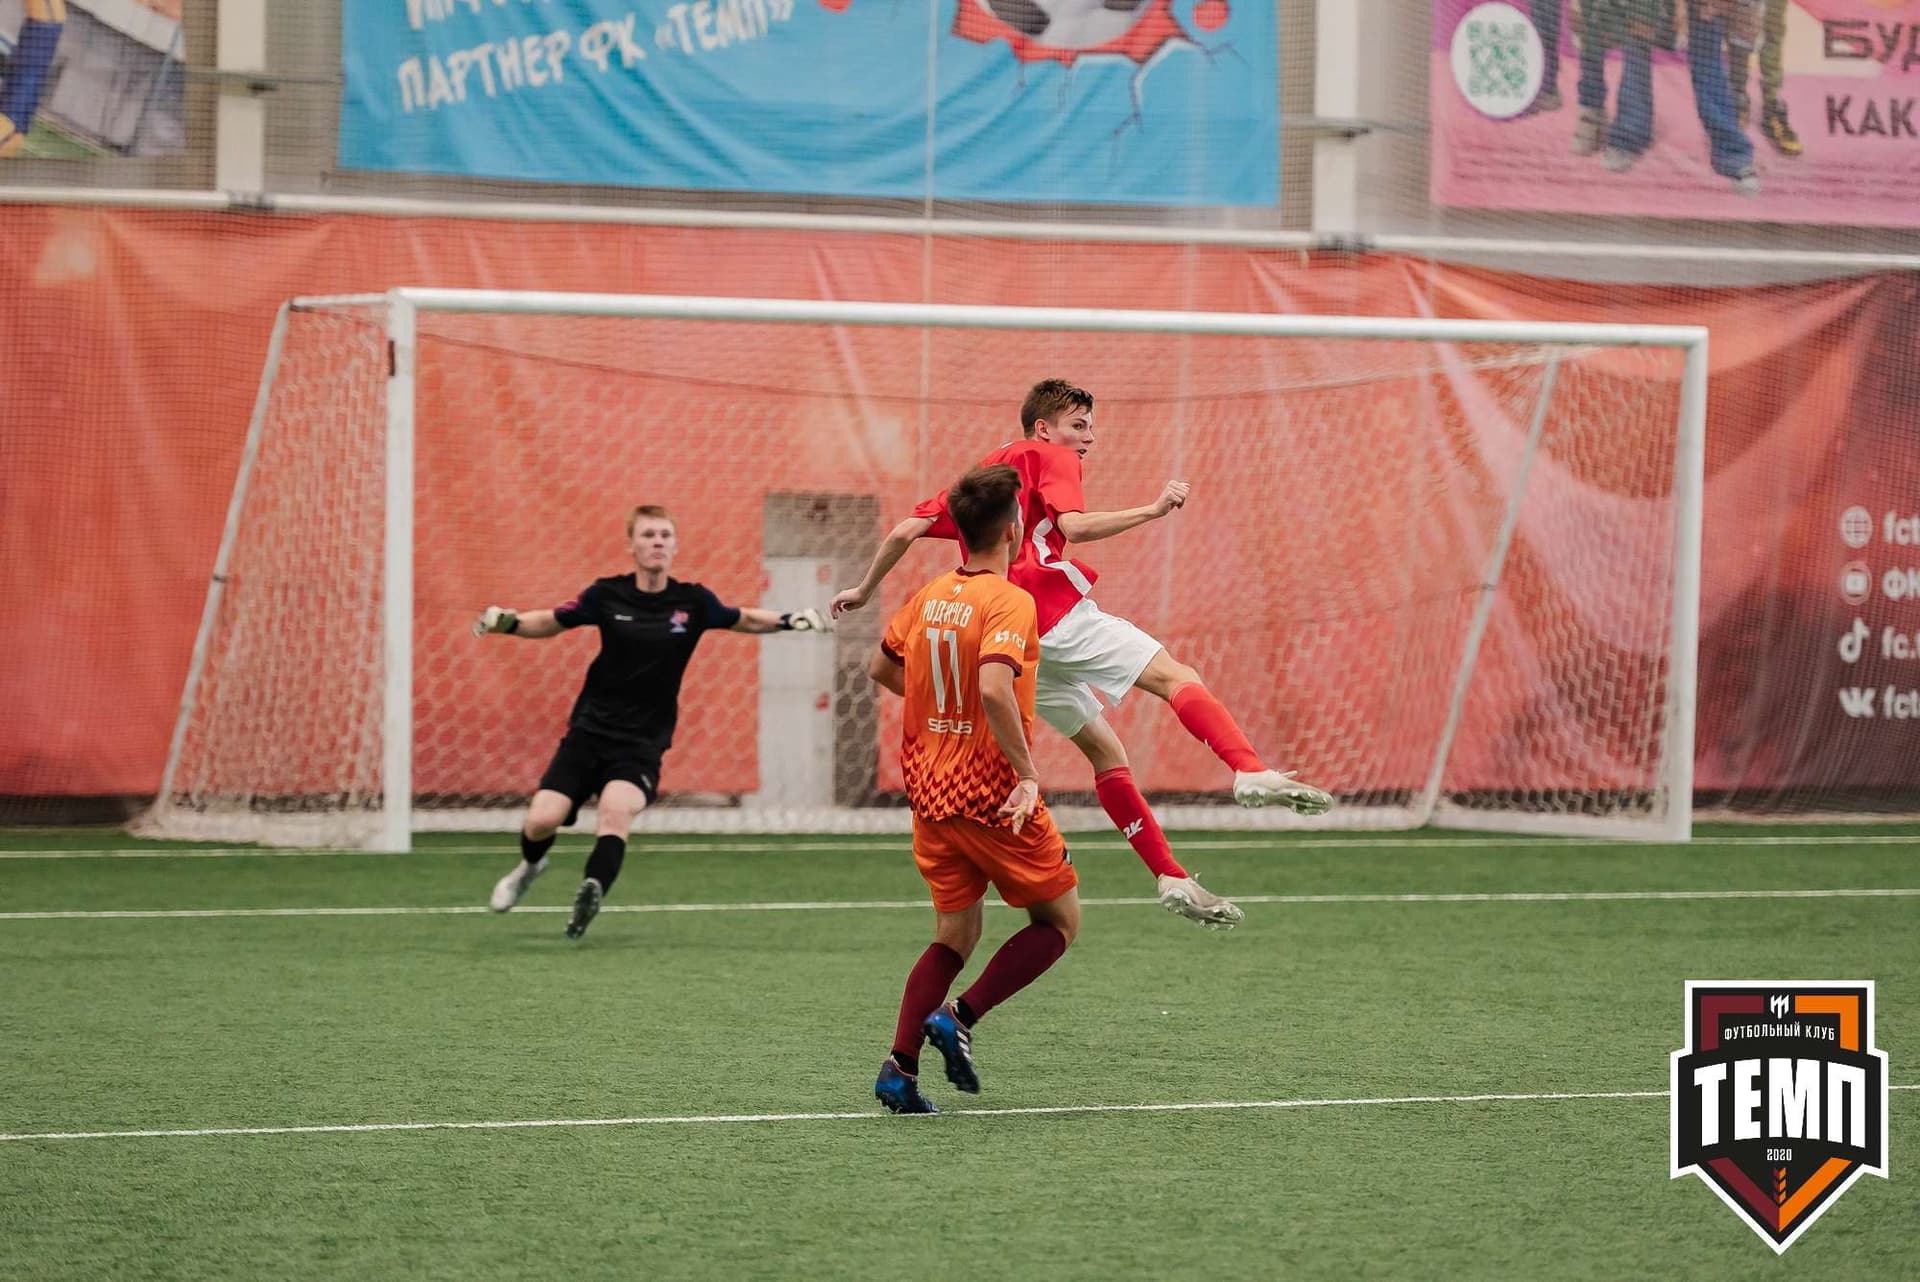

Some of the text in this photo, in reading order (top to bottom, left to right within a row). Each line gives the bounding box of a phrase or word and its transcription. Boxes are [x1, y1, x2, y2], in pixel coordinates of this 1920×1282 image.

[398, 31, 571, 113] ПАРТНЕР
[579, 12, 646, 73] ФК
[1826, 95, 1919, 137] КАК
[926, 627, 963, 714] 11
